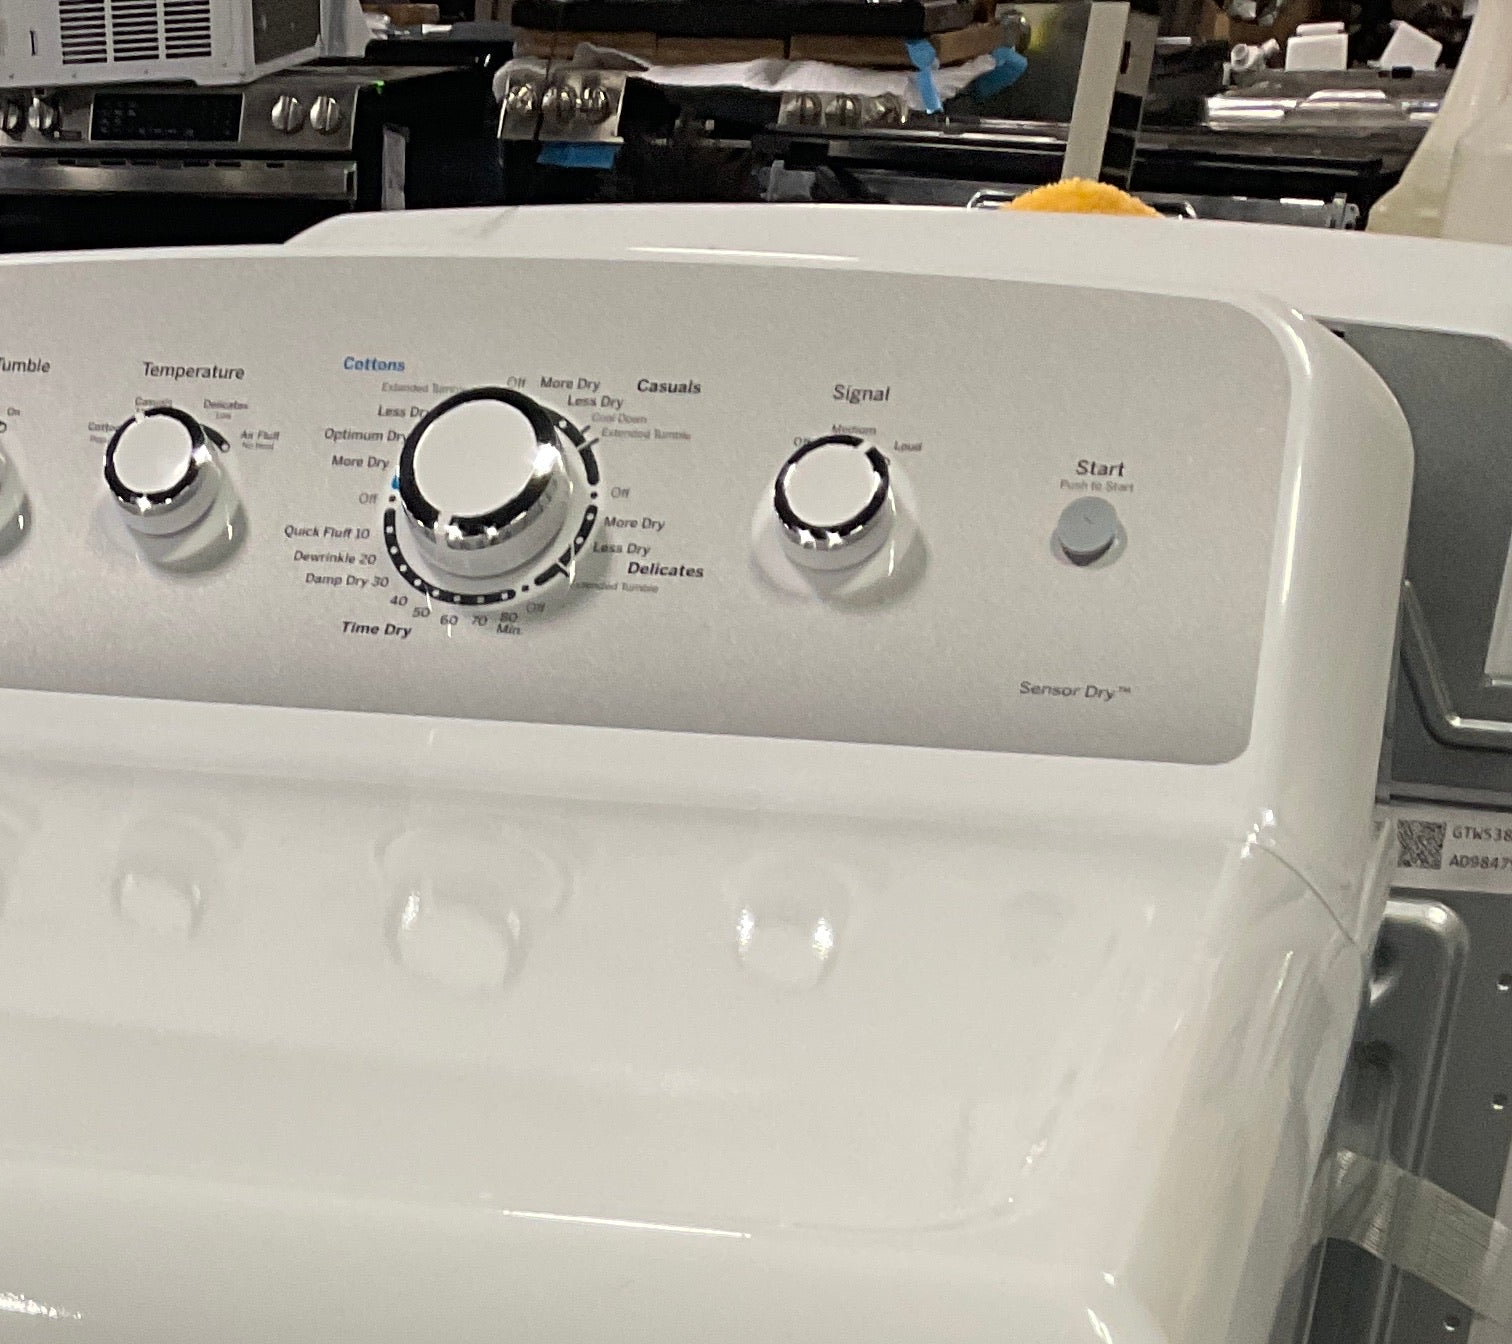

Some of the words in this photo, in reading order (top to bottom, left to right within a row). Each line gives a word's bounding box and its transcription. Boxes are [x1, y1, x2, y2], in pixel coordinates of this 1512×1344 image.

[143, 361, 245, 380] Temperature
[343, 356, 405, 372] Cottons
[540, 376, 573, 390] More
[577, 377, 600, 392] Dry
[637, 379, 701, 394] Casuals
[567, 394, 597, 407] Less
[600, 395, 623, 410] Dry
[833, 384, 890, 404] Signal
[377, 404, 406, 418] Less
[324, 427, 383, 443] Optimum
[331, 455, 364, 468] More
[367, 456, 390, 471] Dry
[1076, 459, 1125, 477] Start
[358, 493, 378, 505] Off
[610, 486, 630, 499] Off
[284, 524, 319, 539] Quick
[322, 526, 352, 540] Fluff
[355, 527, 370, 540] 10
[604, 516, 638, 528] More
[641, 517, 665, 532] Dry
[592, 541, 623, 553] Less
[626, 543, 650, 558] Dry
[293, 550, 356, 565] Dewrinkle
[358, 553, 377, 566] 20
[627, 561, 704, 578] Delicates
[305, 572, 343, 588] Damp
[346, 573, 368, 590] Dry
[371, 576, 390, 588] 30
[390, 595, 408, 607] 40
[412, 606, 431, 619] 50
[440, 614, 459, 627] 60
[342, 619, 380, 636] Time
[384, 621, 413, 639] Dry
[471, 615, 488, 627] 70
[1019, 680, 1081, 697] Sensor
